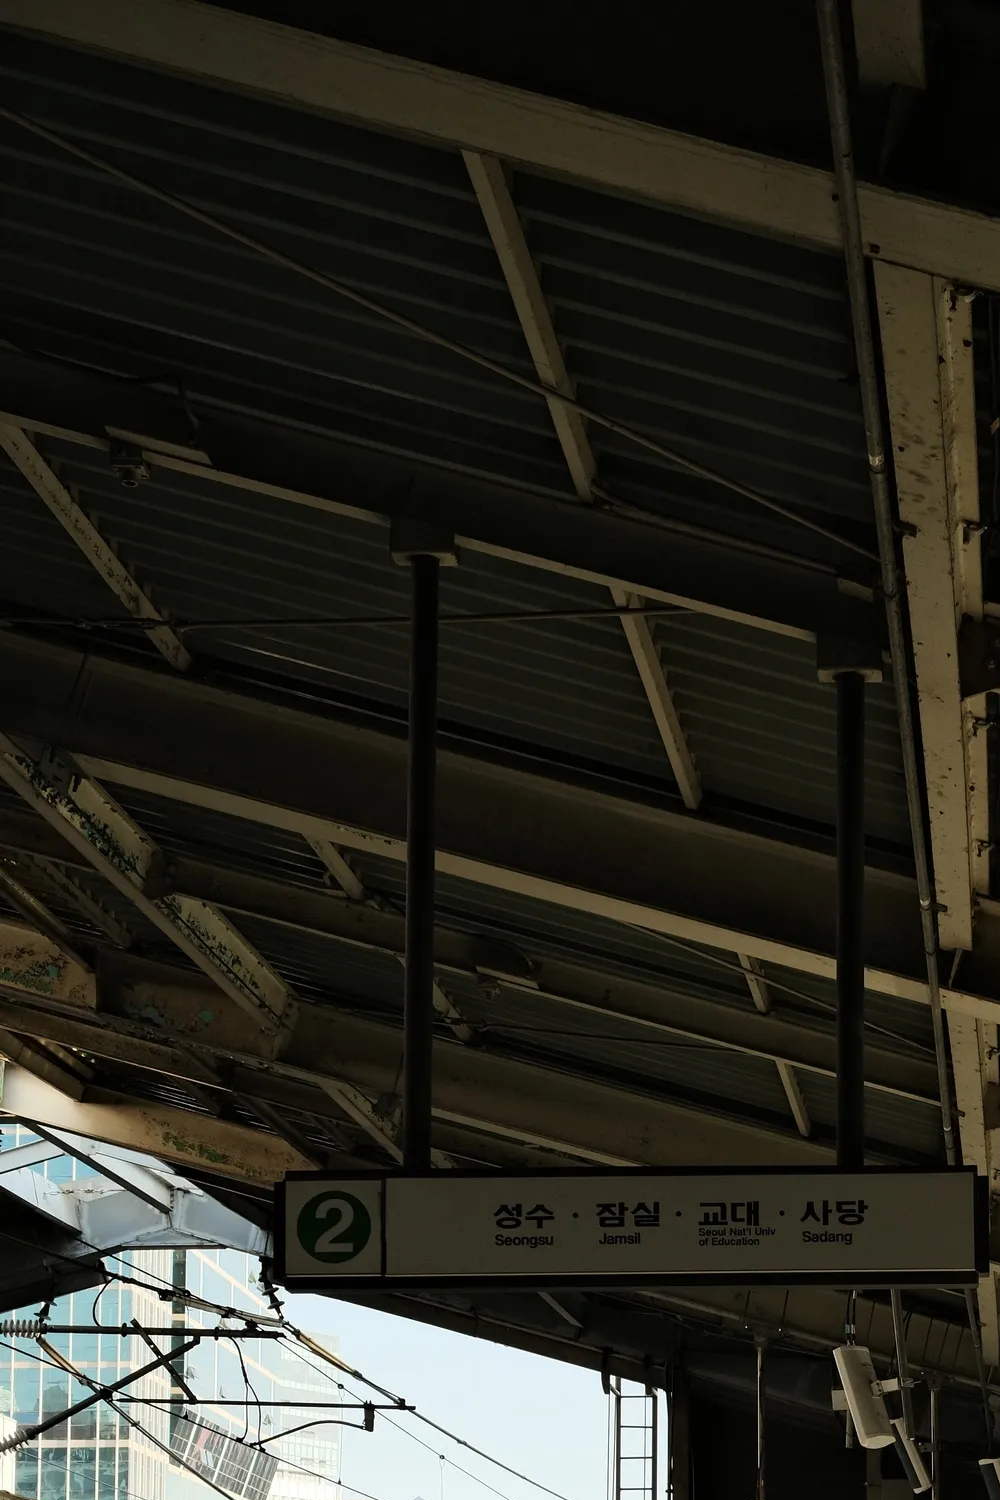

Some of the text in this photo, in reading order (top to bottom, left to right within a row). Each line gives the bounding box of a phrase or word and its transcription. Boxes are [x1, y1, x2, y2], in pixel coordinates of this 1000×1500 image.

[494, 1200, 868, 1229] 성수 잠실 교대 사당
[314, 1198, 354, 1254] 2
[698, 1227, 776, 1236] Seoul Nat'l Univ
[495, 1234, 554, 1248] Seongsu
[599, 1233, 641, 1245] Jamsil
[698, 1237, 760, 1246] of Education
[802, 1231, 853, 1245] Sadang
